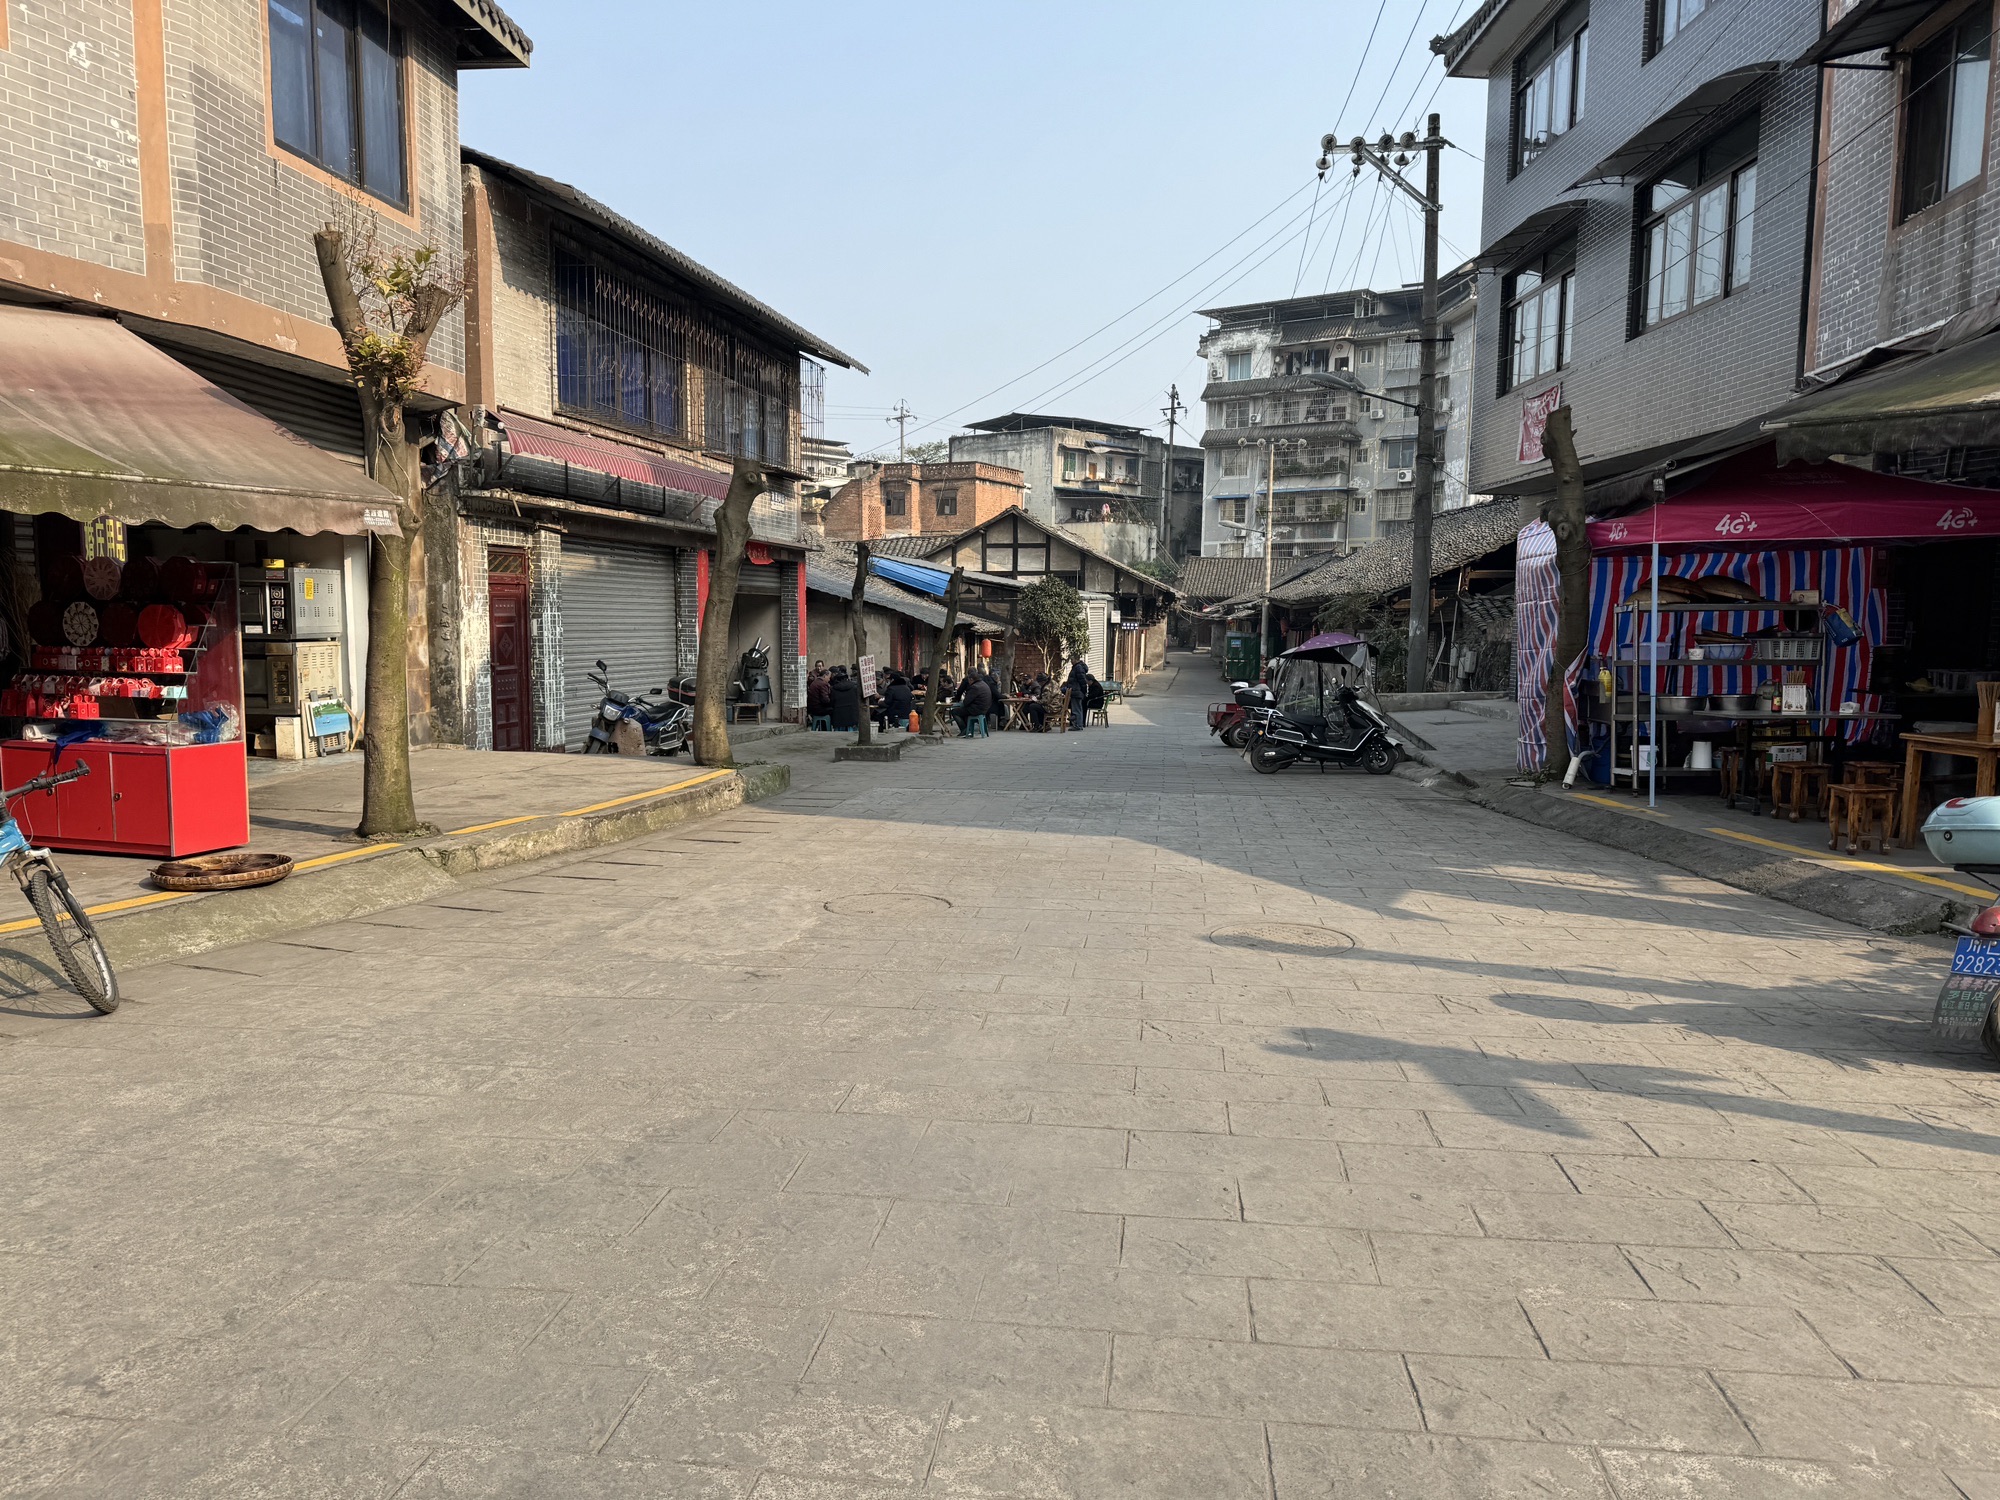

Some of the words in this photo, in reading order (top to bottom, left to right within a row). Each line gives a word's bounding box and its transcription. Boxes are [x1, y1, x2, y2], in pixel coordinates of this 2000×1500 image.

[1715, 512, 1757, 536] 4G+
[1936, 508, 1978, 530] 4G+
[1609, 523, 1628, 542] 4G+
